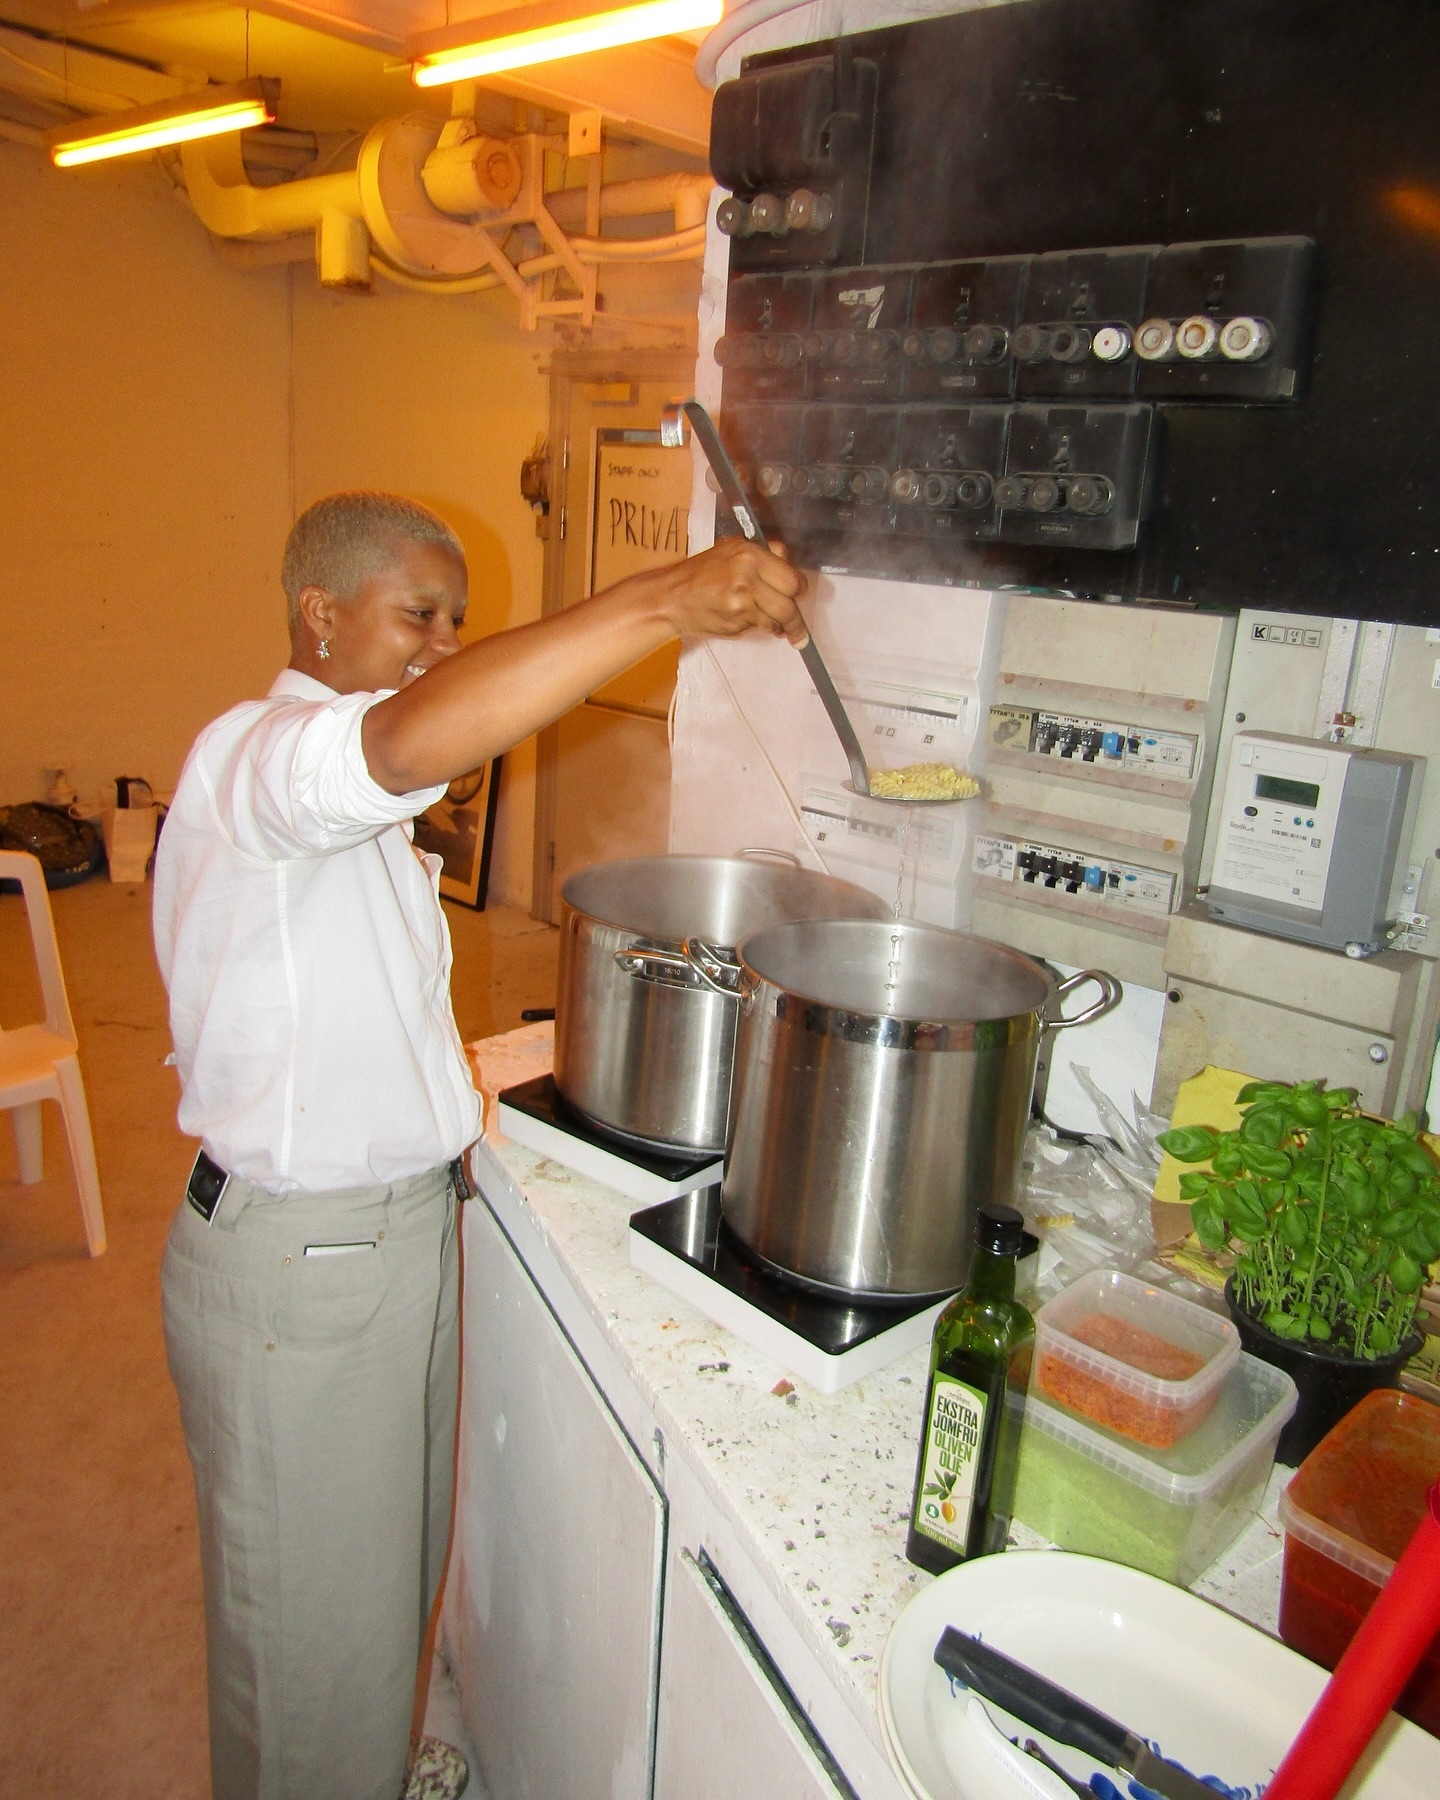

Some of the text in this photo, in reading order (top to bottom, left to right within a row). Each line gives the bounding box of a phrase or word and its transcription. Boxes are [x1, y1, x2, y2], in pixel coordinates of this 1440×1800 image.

[608, 463, 659, 478] STAFF ONLY
[937, 1394, 978, 1430] EKSTRA
[933, 1412, 978, 1447] JOMFRU
[935, 1430, 972, 1463] OLIVEN
[939, 1450, 963, 1476] OLIE
